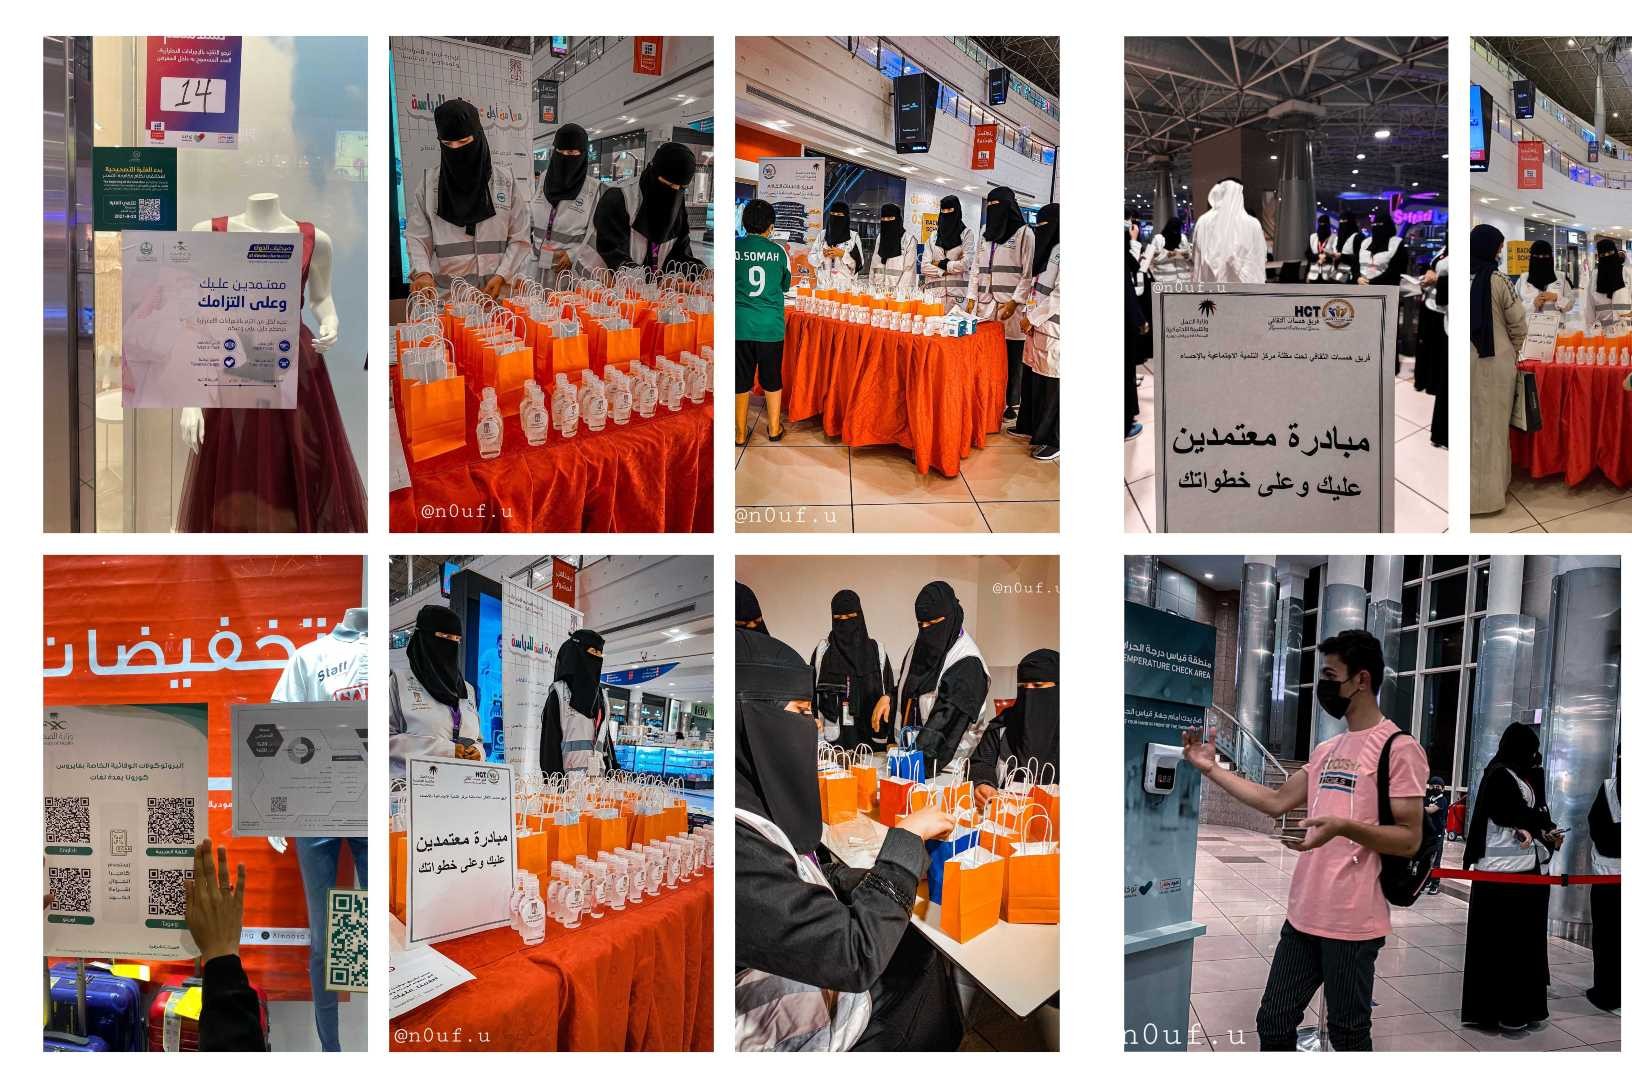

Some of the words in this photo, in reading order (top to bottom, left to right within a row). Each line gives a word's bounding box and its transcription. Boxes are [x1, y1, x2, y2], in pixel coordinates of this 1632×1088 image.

[174, 79, 212, 115] 14
[199, 277, 229, 292] عليك
[232, 278, 287, 292] معتمدين
[748, 265, 766, 297] 9
[197, 294, 246, 311] التزامك
[249, 295, 288, 312] وعلى
[1294, 305, 1321, 318] HCT
[1172, 423, 1277, 454] معتمدين
[1288, 422, 1370, 459] مبادرة
[1178, 469, 1251, 494] خطواتك
[1316, 474, 1362, 502] عليك
[1145, 644, 1165, 658] درجة
[1165, 651, 1188, 662] قياس
[1188, 655, 1212, 669] منطقة
[317, 660, 348, 683] Staff
[1171, 664, 1193, 676] CHECK
[1194, 669, 1212, 680] AREA
[55, 760, 86, 770] بفايروس
[86, 760, 110, 769] الخاصة
[111, 759, 138, 769] الوقائية
[138, 759, 185, 770] البروتوكولات
[124, 774, 150, 782] كورونا
[416, 833, 470, 852] معتمدين
[473, 830, 508, 848] مبادرة
[418, 860, 458, 875] خطواتك
[486, 855, 505, 867] عليك
